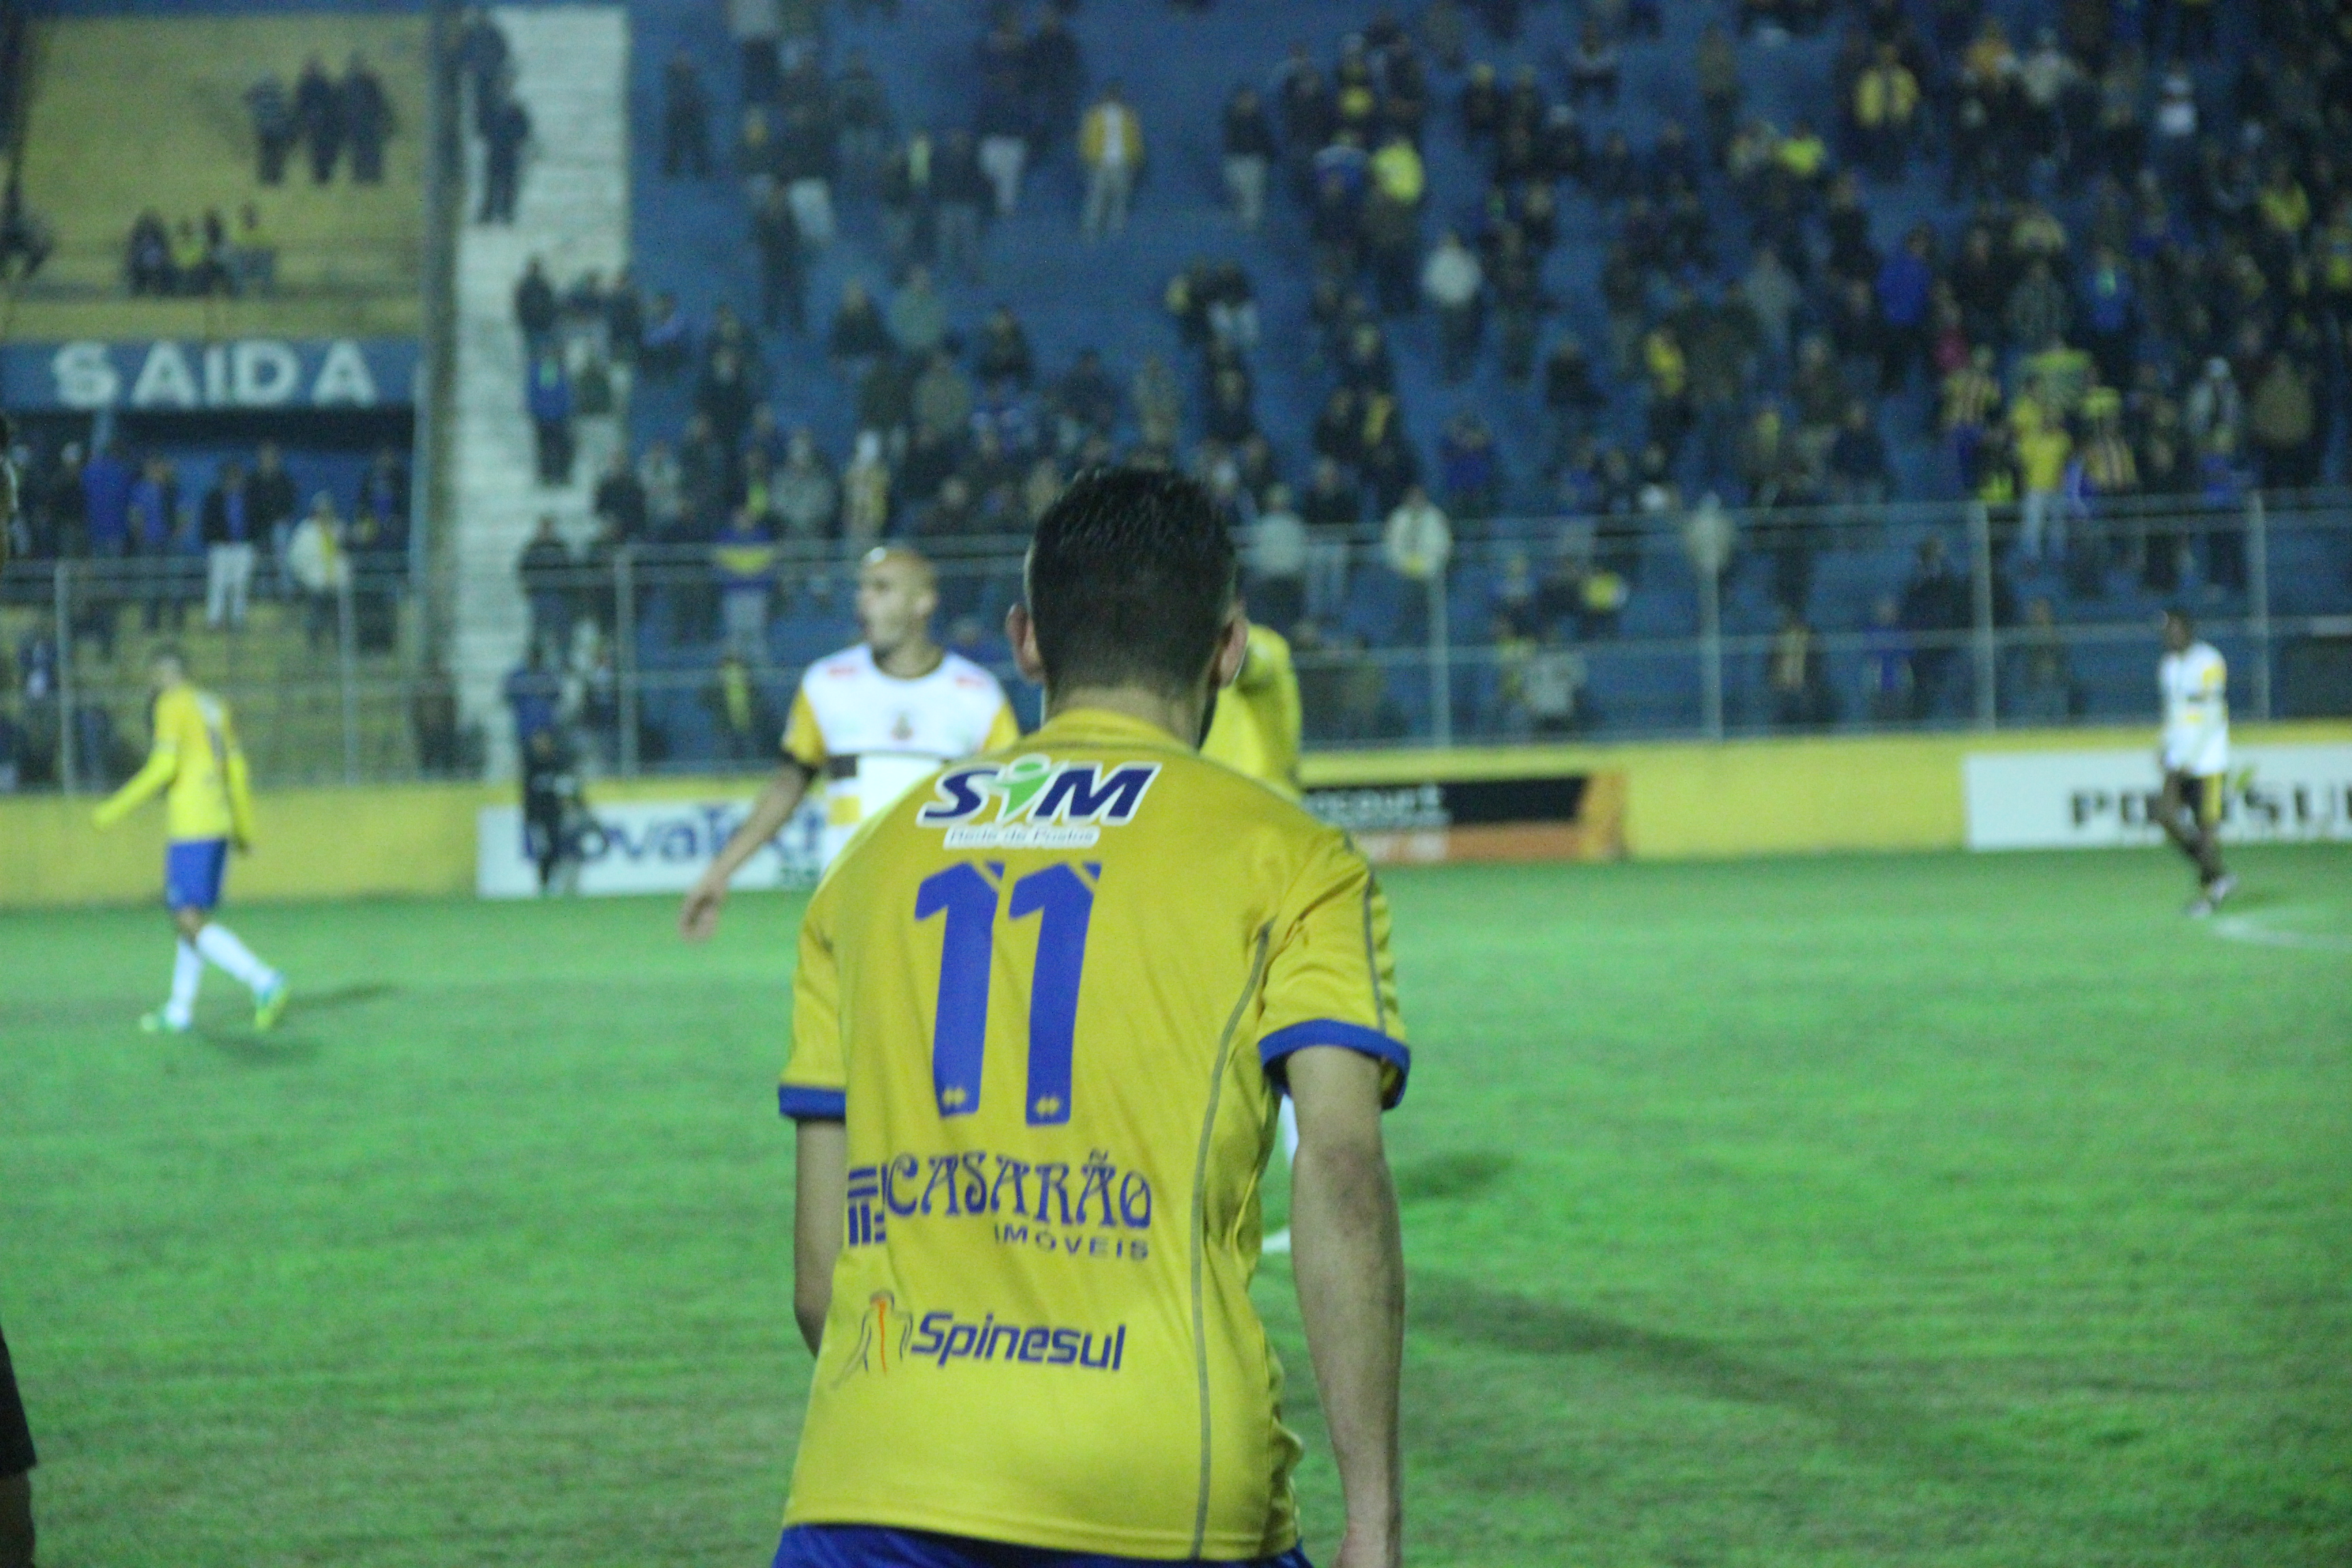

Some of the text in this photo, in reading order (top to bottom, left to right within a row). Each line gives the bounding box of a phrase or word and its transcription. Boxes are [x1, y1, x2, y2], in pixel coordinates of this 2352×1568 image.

[52, 339, 378, 408] SAIDA
[914, 860, 1101, 1126] 11
[885, 1147, 1152, 1230] CASARÃO
[910, 1309, 1127, 1372] Spinesul
